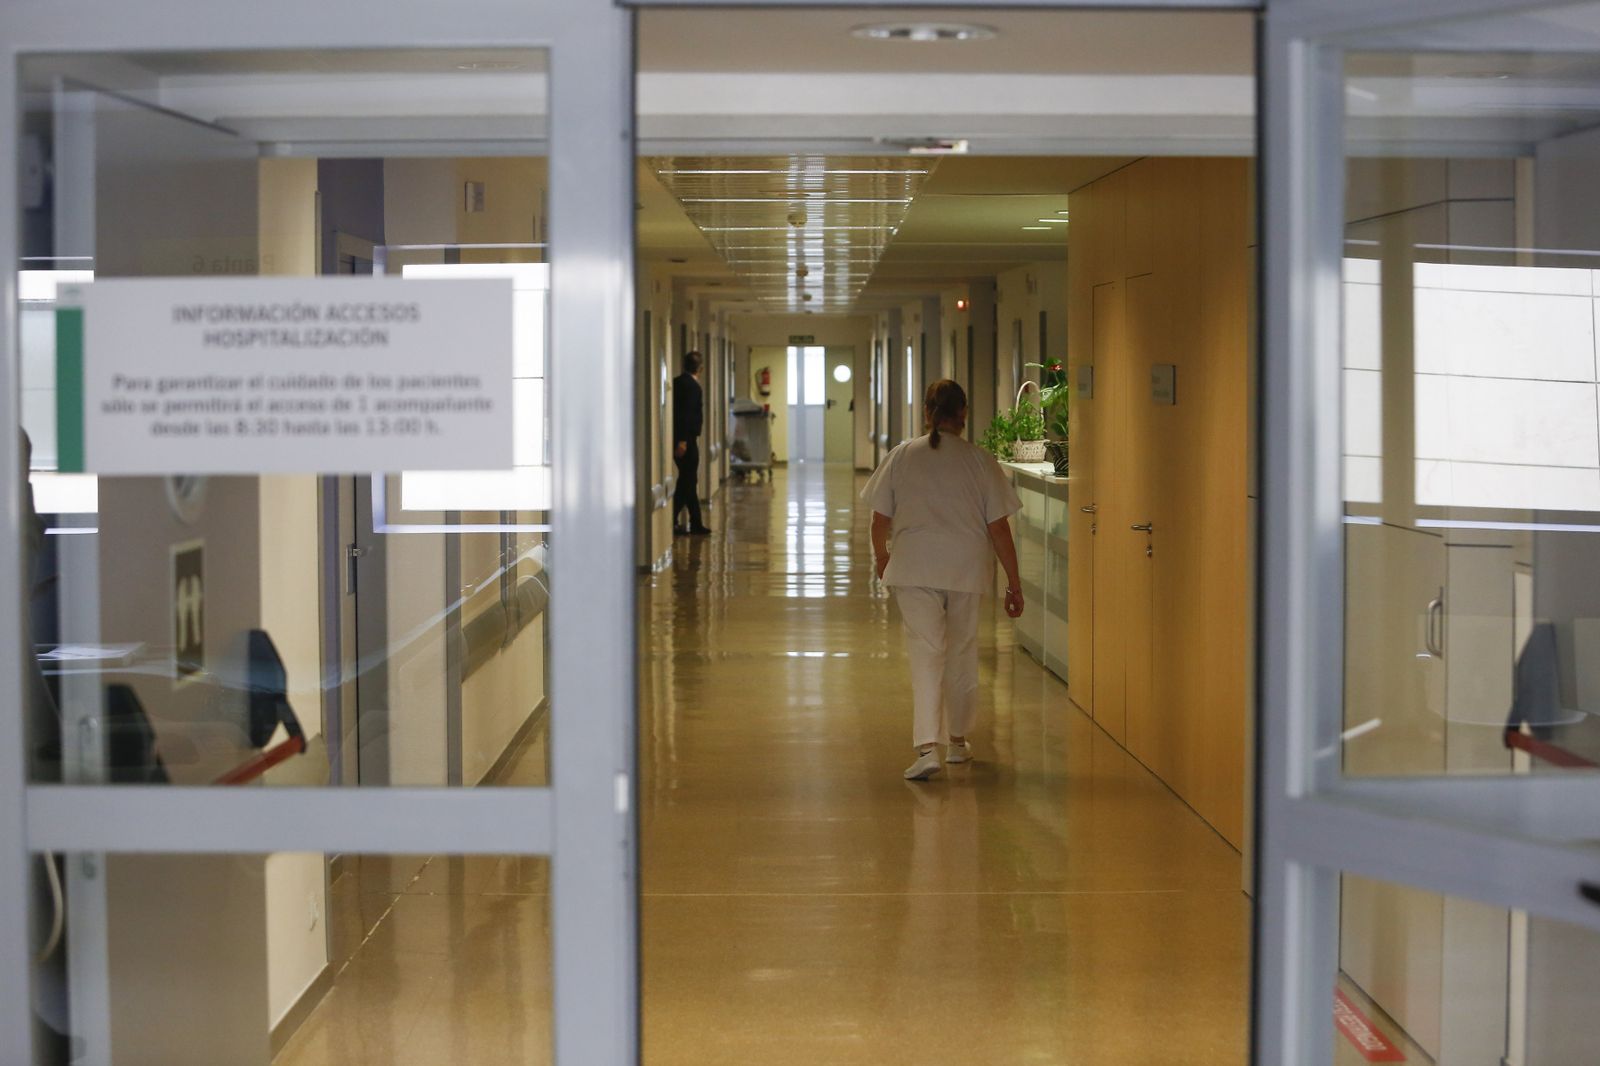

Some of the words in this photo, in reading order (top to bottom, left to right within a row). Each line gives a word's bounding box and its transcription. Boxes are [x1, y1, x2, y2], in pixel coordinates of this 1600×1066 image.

[172, 302, 319, 323] INFORMACIÓN
[325, 303, 420, 322] ACCESOS
[203, 327, 389, 348] HOSPITALIZACIÓN
[112, 374, 152, 390] Para
[156, 375, 243, 394] garantizar
[247, 375, 263, 390] el
[268, 375, 336, 390] cuidado
[343, 374, 363, 389] de
[367, 374, 394, 389] los
[398, 374, 481, 393] pacientes
[140, 402, 157, 414] se
[247, 399, 262, 414] el
[268, 401, 325, 414] acceso
[333, 398, 352, 413] de
[359, 396, 367, 413] 1
[374, 397, 493, 415] acompañante
[151, 420, 200, 436] desde
[206, 420, 229, 436] las
[283, 418, 331, 436] hasta
[334, 418, 361, 435] las
